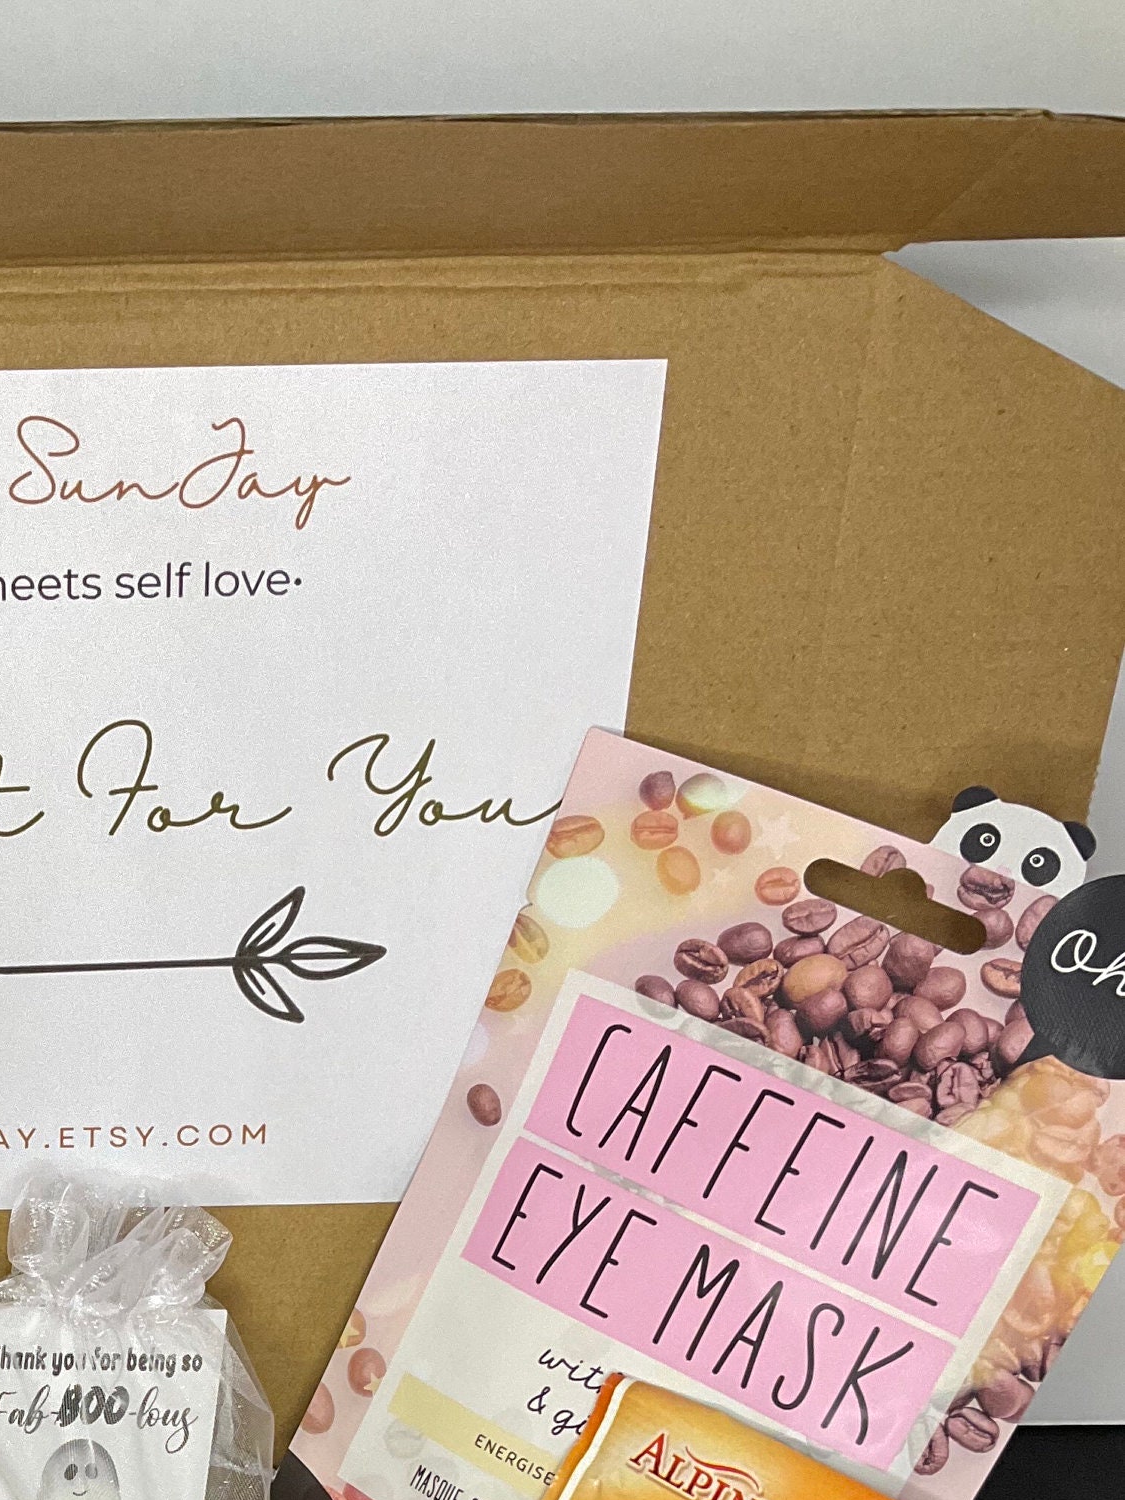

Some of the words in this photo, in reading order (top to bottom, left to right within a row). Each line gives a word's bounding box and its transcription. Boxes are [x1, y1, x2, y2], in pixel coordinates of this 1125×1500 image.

[114, 562, 192, 598] self
[77, 719, 292, 836] For
[327, 733, 565, 836] You
[566, 1024, 999, 1307] CAFFEINE
[491, 1162, 658, 1319] EYE
[652, 1243, 914, 1446] MASK
[126, 1347, 177, 1378] being
[181, 1353, 203, 1372] so
[537, 1349, 605, 1394] wit
[527, 1386, 551, 1415] &
[474, 1433, 556, 1486] ENERGISE
